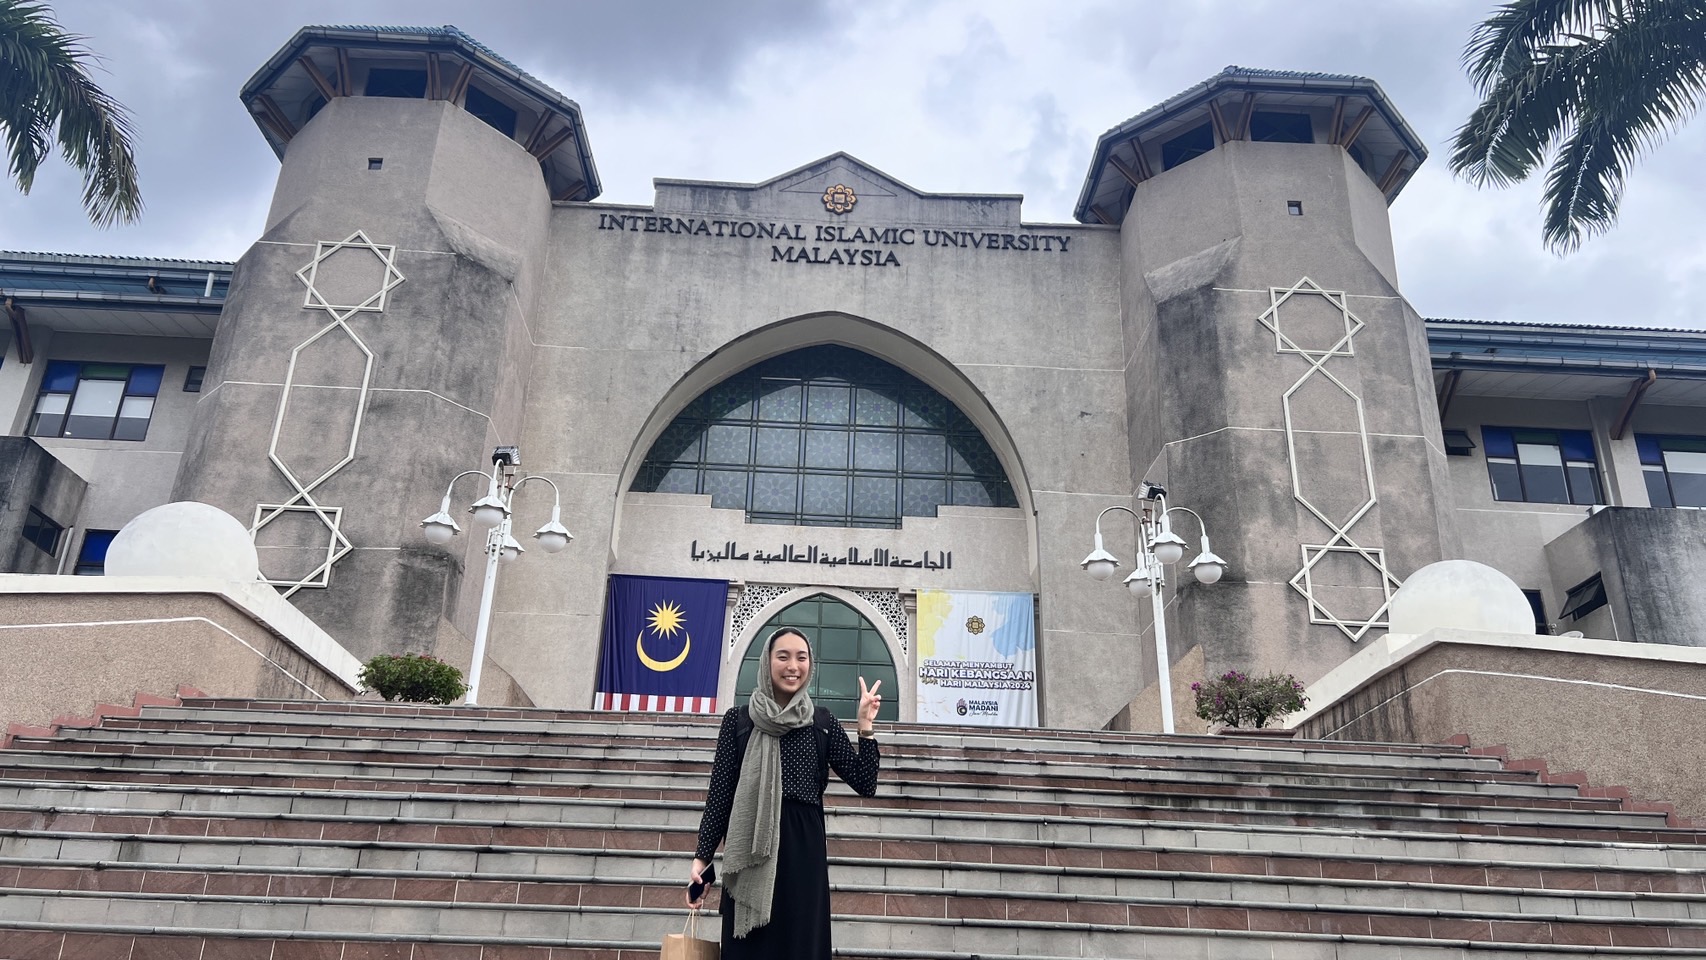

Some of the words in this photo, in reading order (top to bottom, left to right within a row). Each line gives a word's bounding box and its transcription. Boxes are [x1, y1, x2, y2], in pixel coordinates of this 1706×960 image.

[599, 214, 806, 240] INTERNATIONAL
[815, 226, 915, 244] ISLAMIC
[922, 229, 1071, 251] UNIVERSITY
[771, 245, 901, 267] MALAYSIA
[753, 543, 818, 564] العالمية
[890, 550, 952, 570] الجامعة
[919, 667, 949, 678] HARI
[951, 669, 1033, 681] KEBANGSAAN
[924, 660, 961, 668] SELAMAT
[962, 662, 1014, 670] MENYAMBUT
[940, 679, 962, 688] HARI
[964, 680, 1009, 689] MALAYSIA
[1010, 682, 1032, 690] 2024
